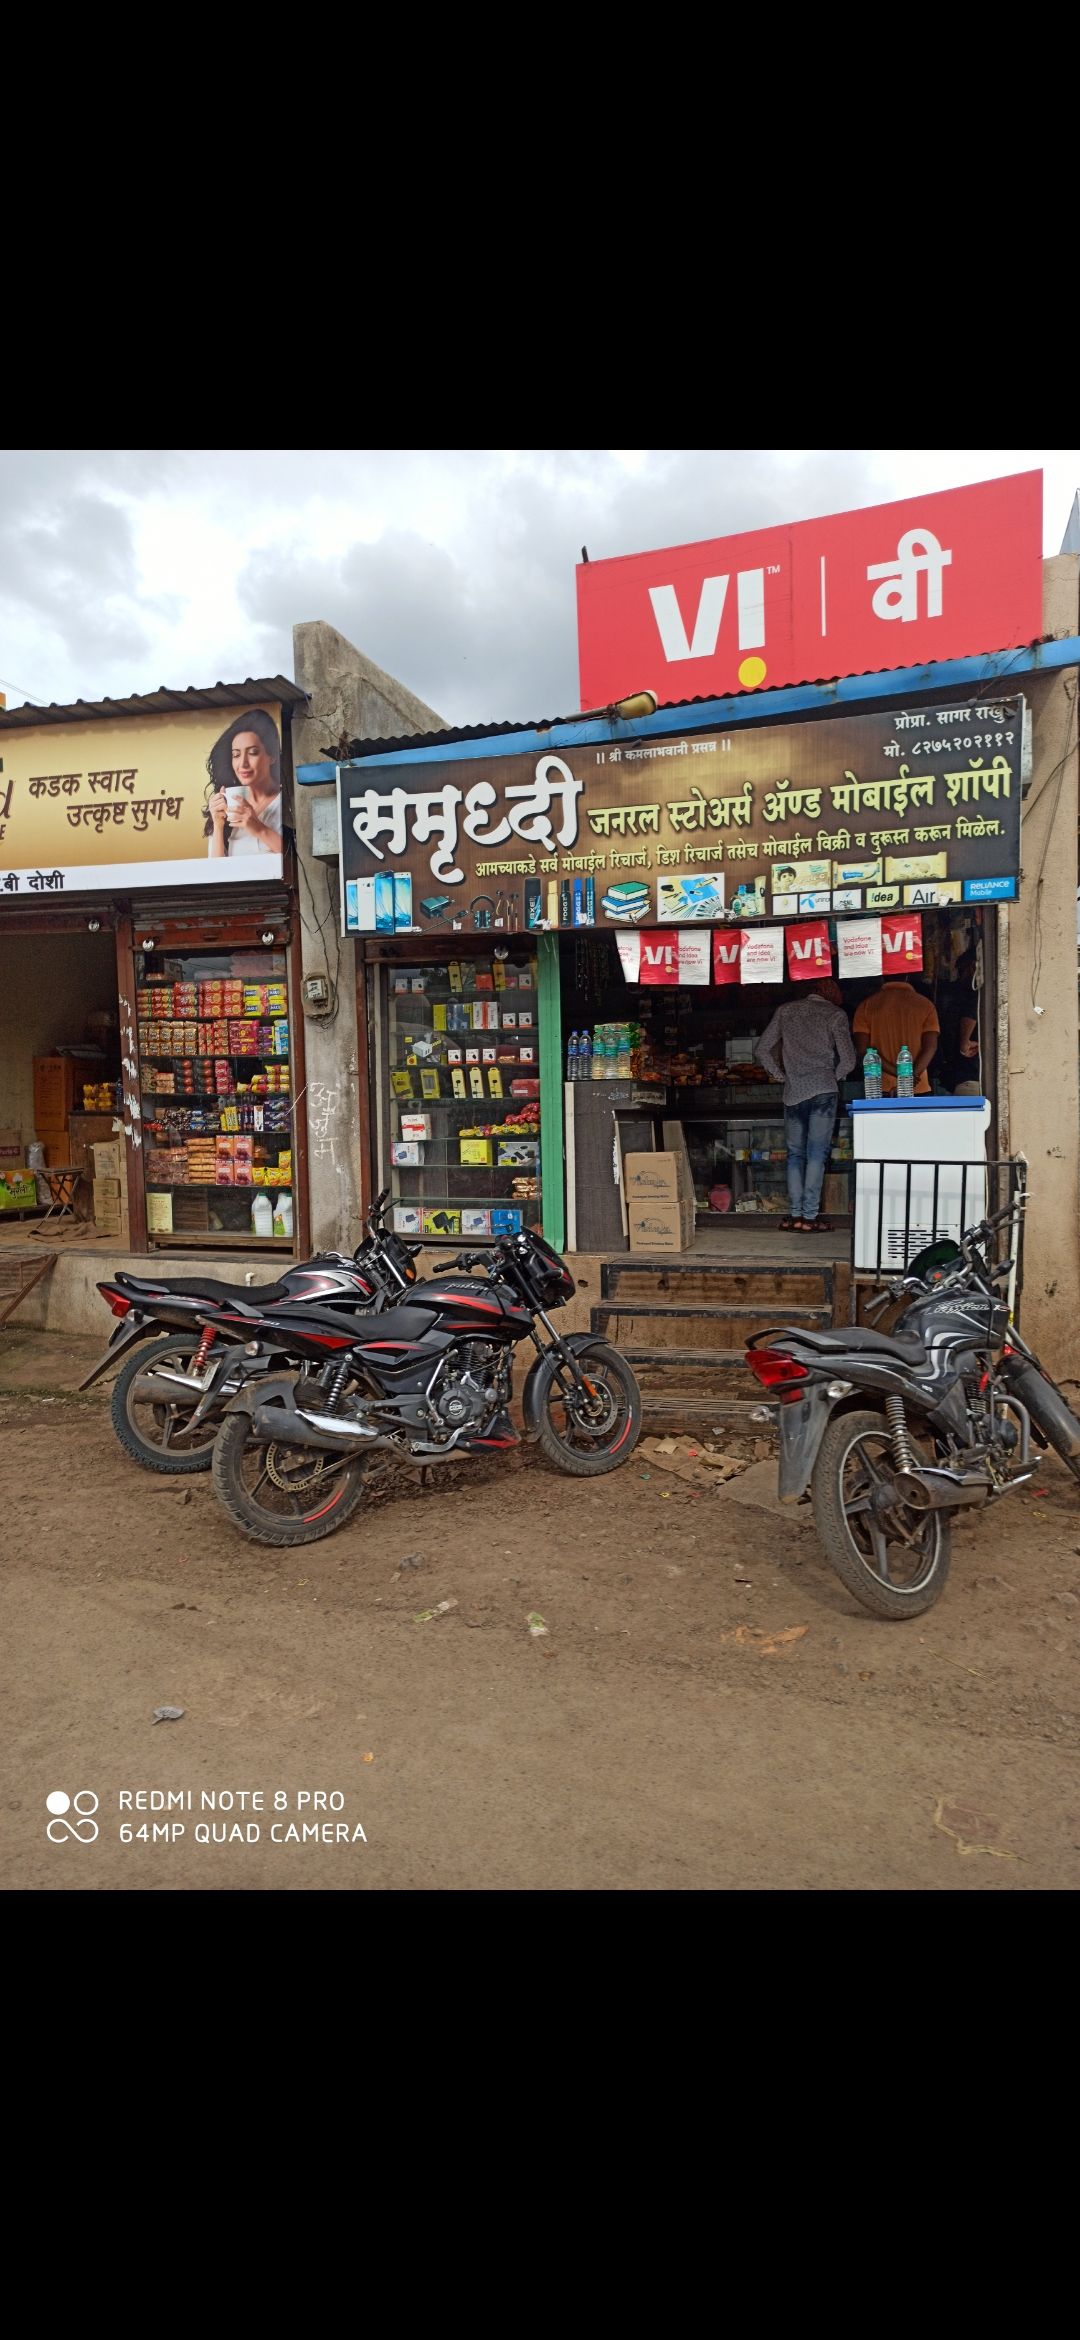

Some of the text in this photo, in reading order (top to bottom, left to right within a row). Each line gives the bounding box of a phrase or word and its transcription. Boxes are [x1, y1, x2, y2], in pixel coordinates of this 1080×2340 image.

[866, 528, 953, 623] वी
[894, 712, 931, 730] प्रोप्रा.
[936, 709, 972, 724] सागर
[609, 748, 622, 762] श्री
[625, 741, 688, 760] कमलाभवानी
[691, 742, 717, 754] प्रसन्न
[883, 731, 1014, 757] मो. ८२७५२०२११२
[29, 769, 138, 798] कडक स्वाद
[587, 804, 660, 835] जनरल
[667, 781, 753, 831] स्टोअर्स
[830, 764, 936, 817] मोबाईल
[944, 755, 1013, 806] शॉपी
[67, 790, 184, 833] उत्कृष्ट सुगंध
[475, 815, 1006, 876] आमच्याकडे सर्व मोबाईल रिचार्ज, डिश रिचार्ज तसेच मोबाईल विक्री व दुरूस्त करून मिळेल.
[27, 870, 65, 891] दोशी
